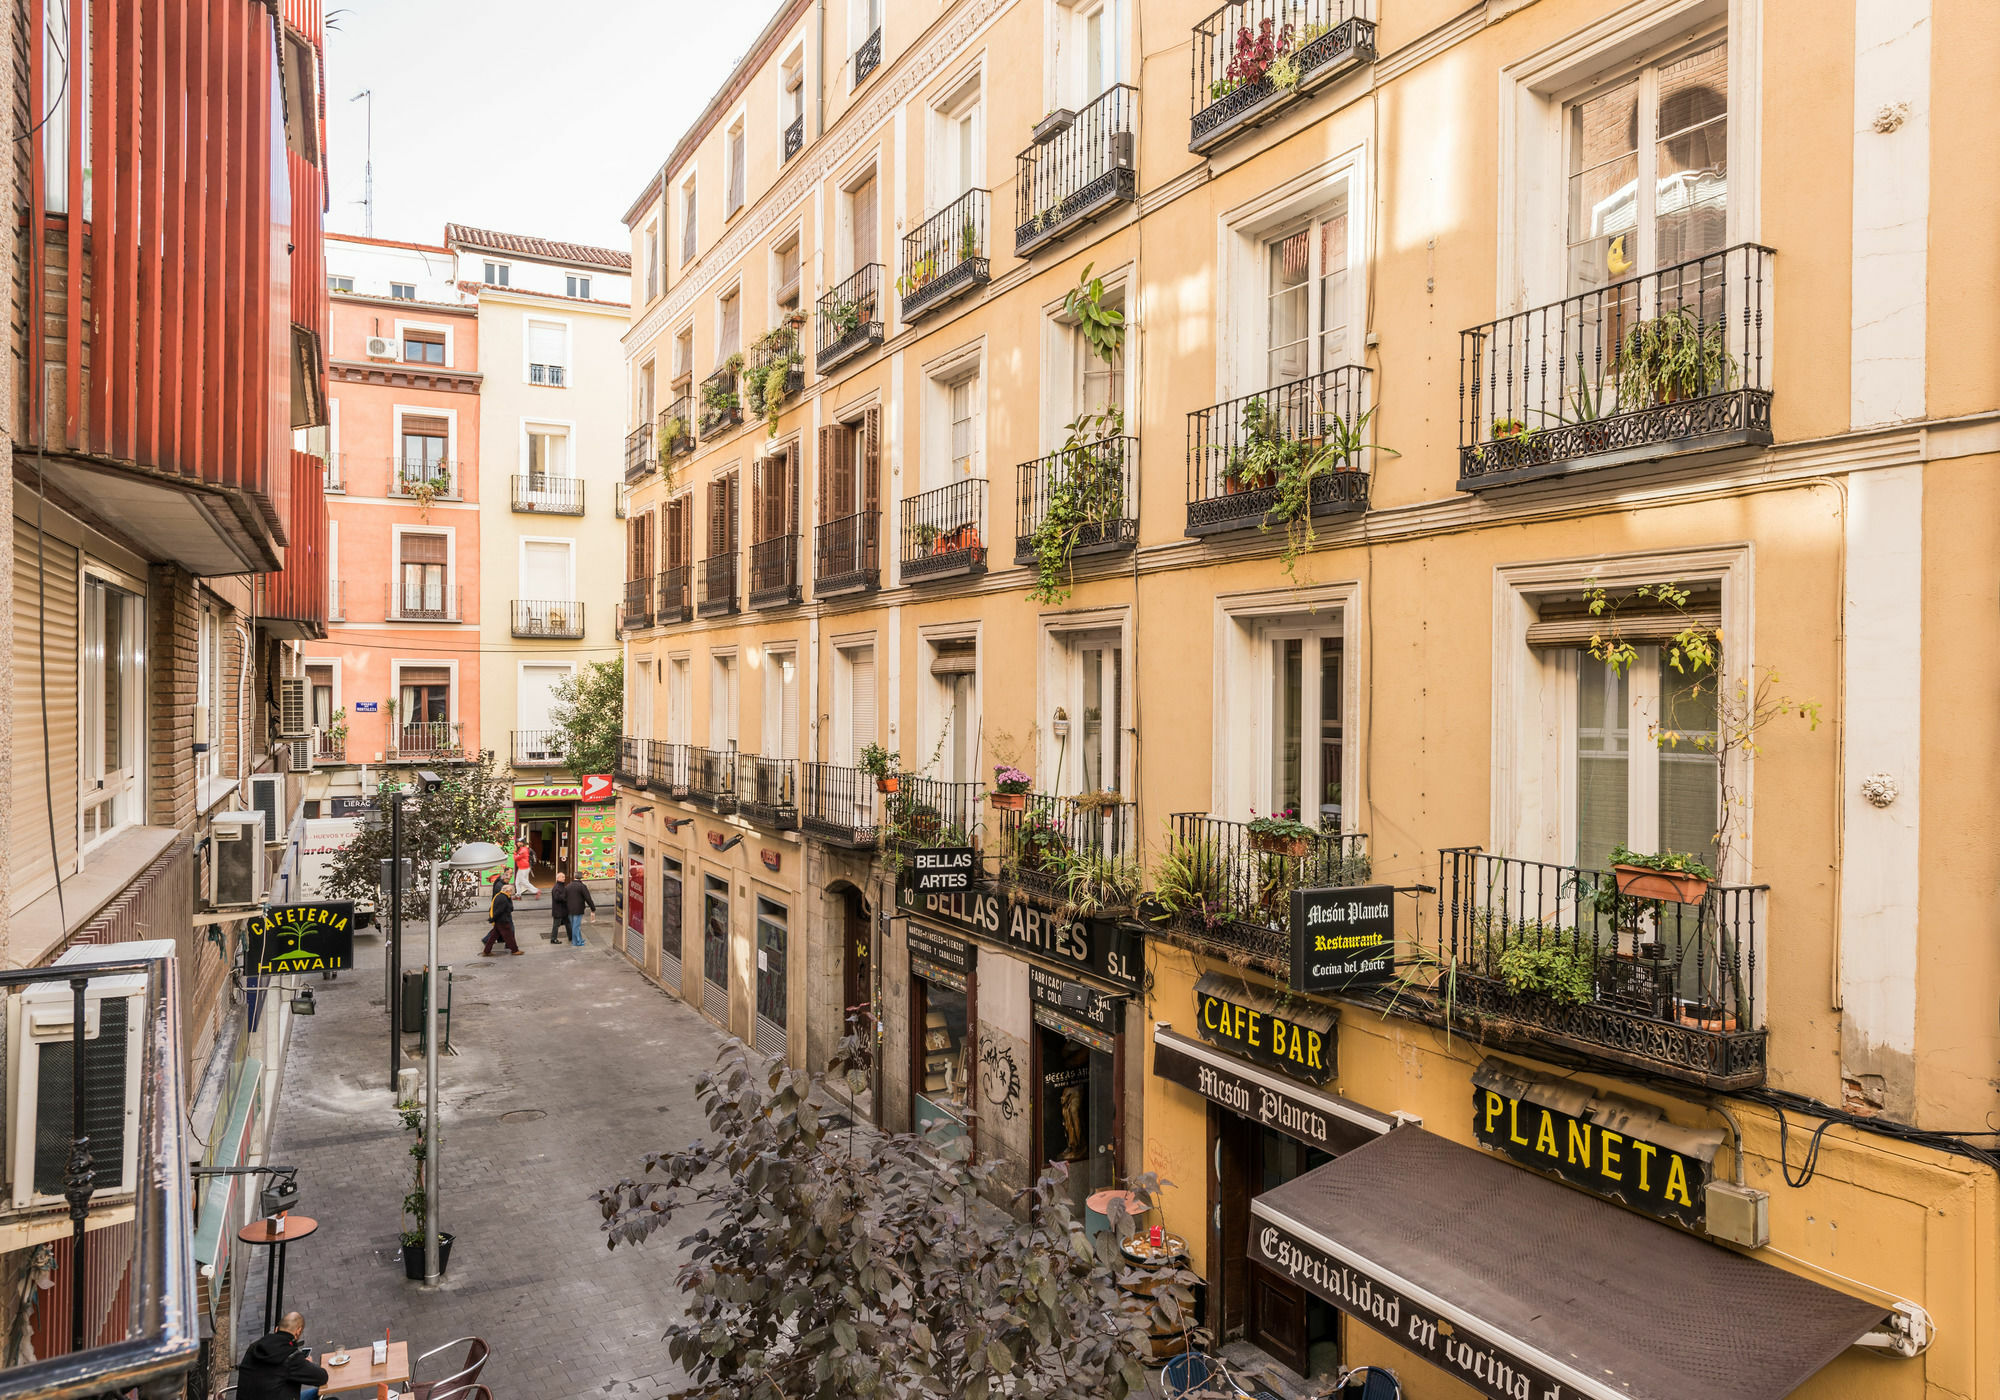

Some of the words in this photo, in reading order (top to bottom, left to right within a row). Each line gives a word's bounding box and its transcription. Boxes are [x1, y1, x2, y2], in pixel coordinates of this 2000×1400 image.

[343, 800, 371, 808] LIERAC
[313, 832, 339, 840] HUEVOS
[303, 845, 333, 855] ardo
[916, 853, 972, 869] BELLAS
[920, 873, 967, 889] ARTES
[903, 888, 914, 906] 10
[251, 907, 348, 936] CAFETERIA
[1306, 902, 1345, 926] Mesón
[1347, 902, 1389, 924] Planeta
[927, 893, 999, 931] BELLAS
[1010, 905, 1088, 961] ARTES
[1107, 952, 1136, 982] S.L.
[1314, 931, 1383, 951] Restaurante
[257, 956, 341, 974] HAWAII
[1312, 963, 1342, 977] Cocina
[1344, 960, 1358, 973] del
[1359, 959, 1385, 973] Norte
[1031, 969, 1065, 992] FABRICACI
[1036, 986, 1044, 999] DE
[1047, 990, 1062, 1006] COLO
[1204, 996, 1261, 1047] CAFE
[1272, 1018, 1323, 1070] BAR
[1198, 1066, 1250, 1112] Mesón
[1259, 1087, 1327, 1142] Planeta
[1485, 1090, 1692, 1208] PLANETA
[1260, 1226, 1400, 1328] Especialidad
[1408, 1313, 1436, 1350] en
[1445, 1338, 1531, 1400] cocina
